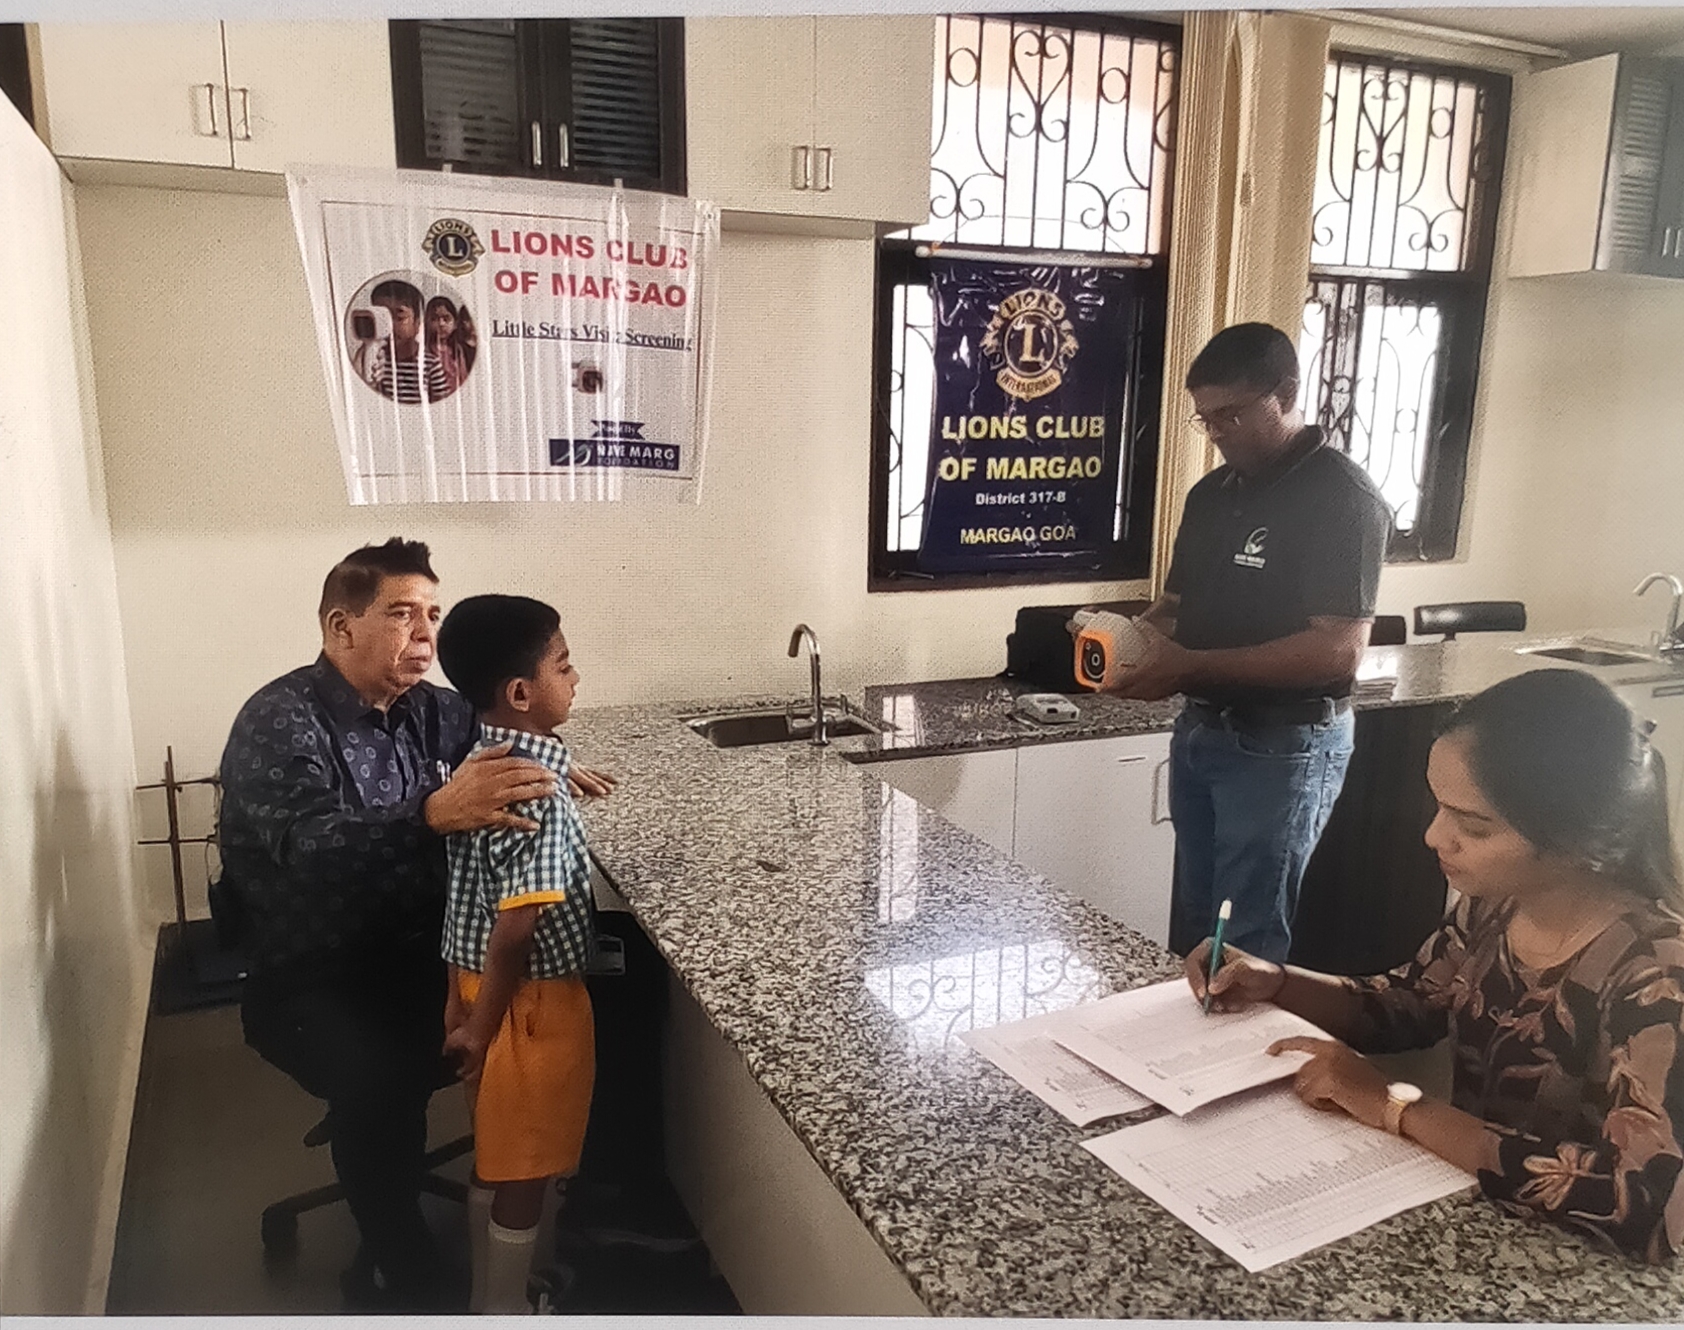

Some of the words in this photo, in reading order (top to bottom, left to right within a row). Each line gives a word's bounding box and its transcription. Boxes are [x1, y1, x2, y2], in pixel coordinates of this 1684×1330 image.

[447, 236, 463, 257] L
[491, 229, 594, 259] LIONS
[606, 240, 688, 269] CLUB
[494, 270, 539, 294] OF
[551, 273, 687, 308] MARGAO
[1004, 291, 1062, 316] LIONS
[539, 322, 578, 341] Sts
[1020, 324, 1045, 362] L
[941, 415, 1027, 440] LIONS
[1036, 415, 1105, 439] CLUB
[629, 446, 675, 460] MARG
[939, 456, 977, 481] OF
[986, 456, 1102, 480] MARGAO
[975, 492, 1026, 505] District
[1029, 491, 1066, 503] 317-B
[960, 526, 1035, 545] MARGAO
[1039, 525, 1076, 542] GOA
